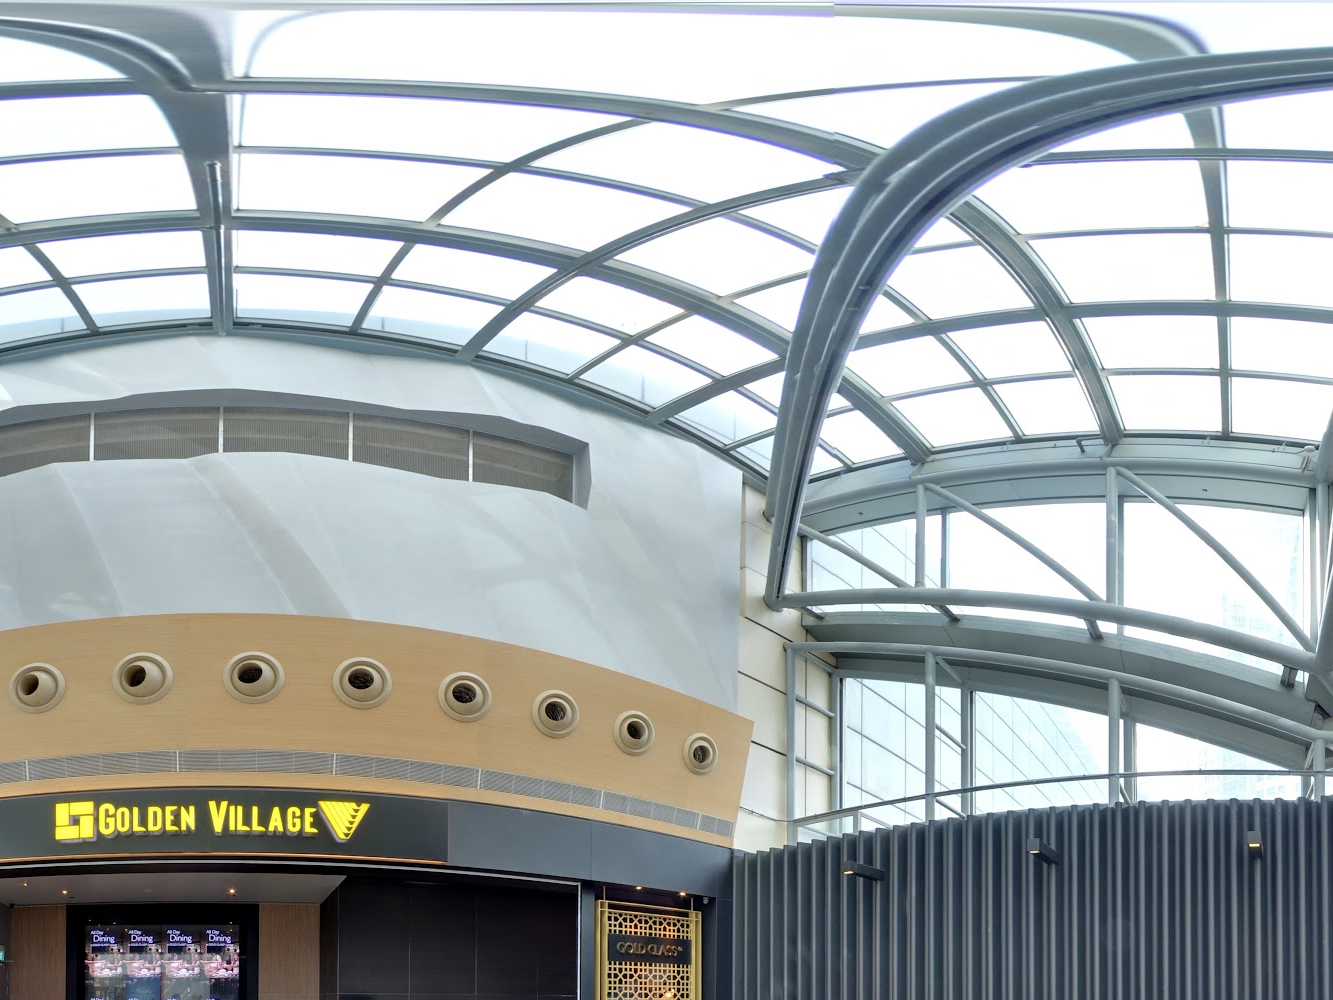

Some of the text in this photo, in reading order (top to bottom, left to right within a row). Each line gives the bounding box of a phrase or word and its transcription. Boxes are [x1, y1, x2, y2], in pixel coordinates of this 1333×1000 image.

[98, 800, 318, 834] GOLDEN VILLAGE
[93, 935, 115, 943] Dining
[131, 935, 153, 943] Dining
[170, 935, 192, 943] Dining
[209, 935, 231, 943] Dining
[617, 942, 646, 954] GOLD
